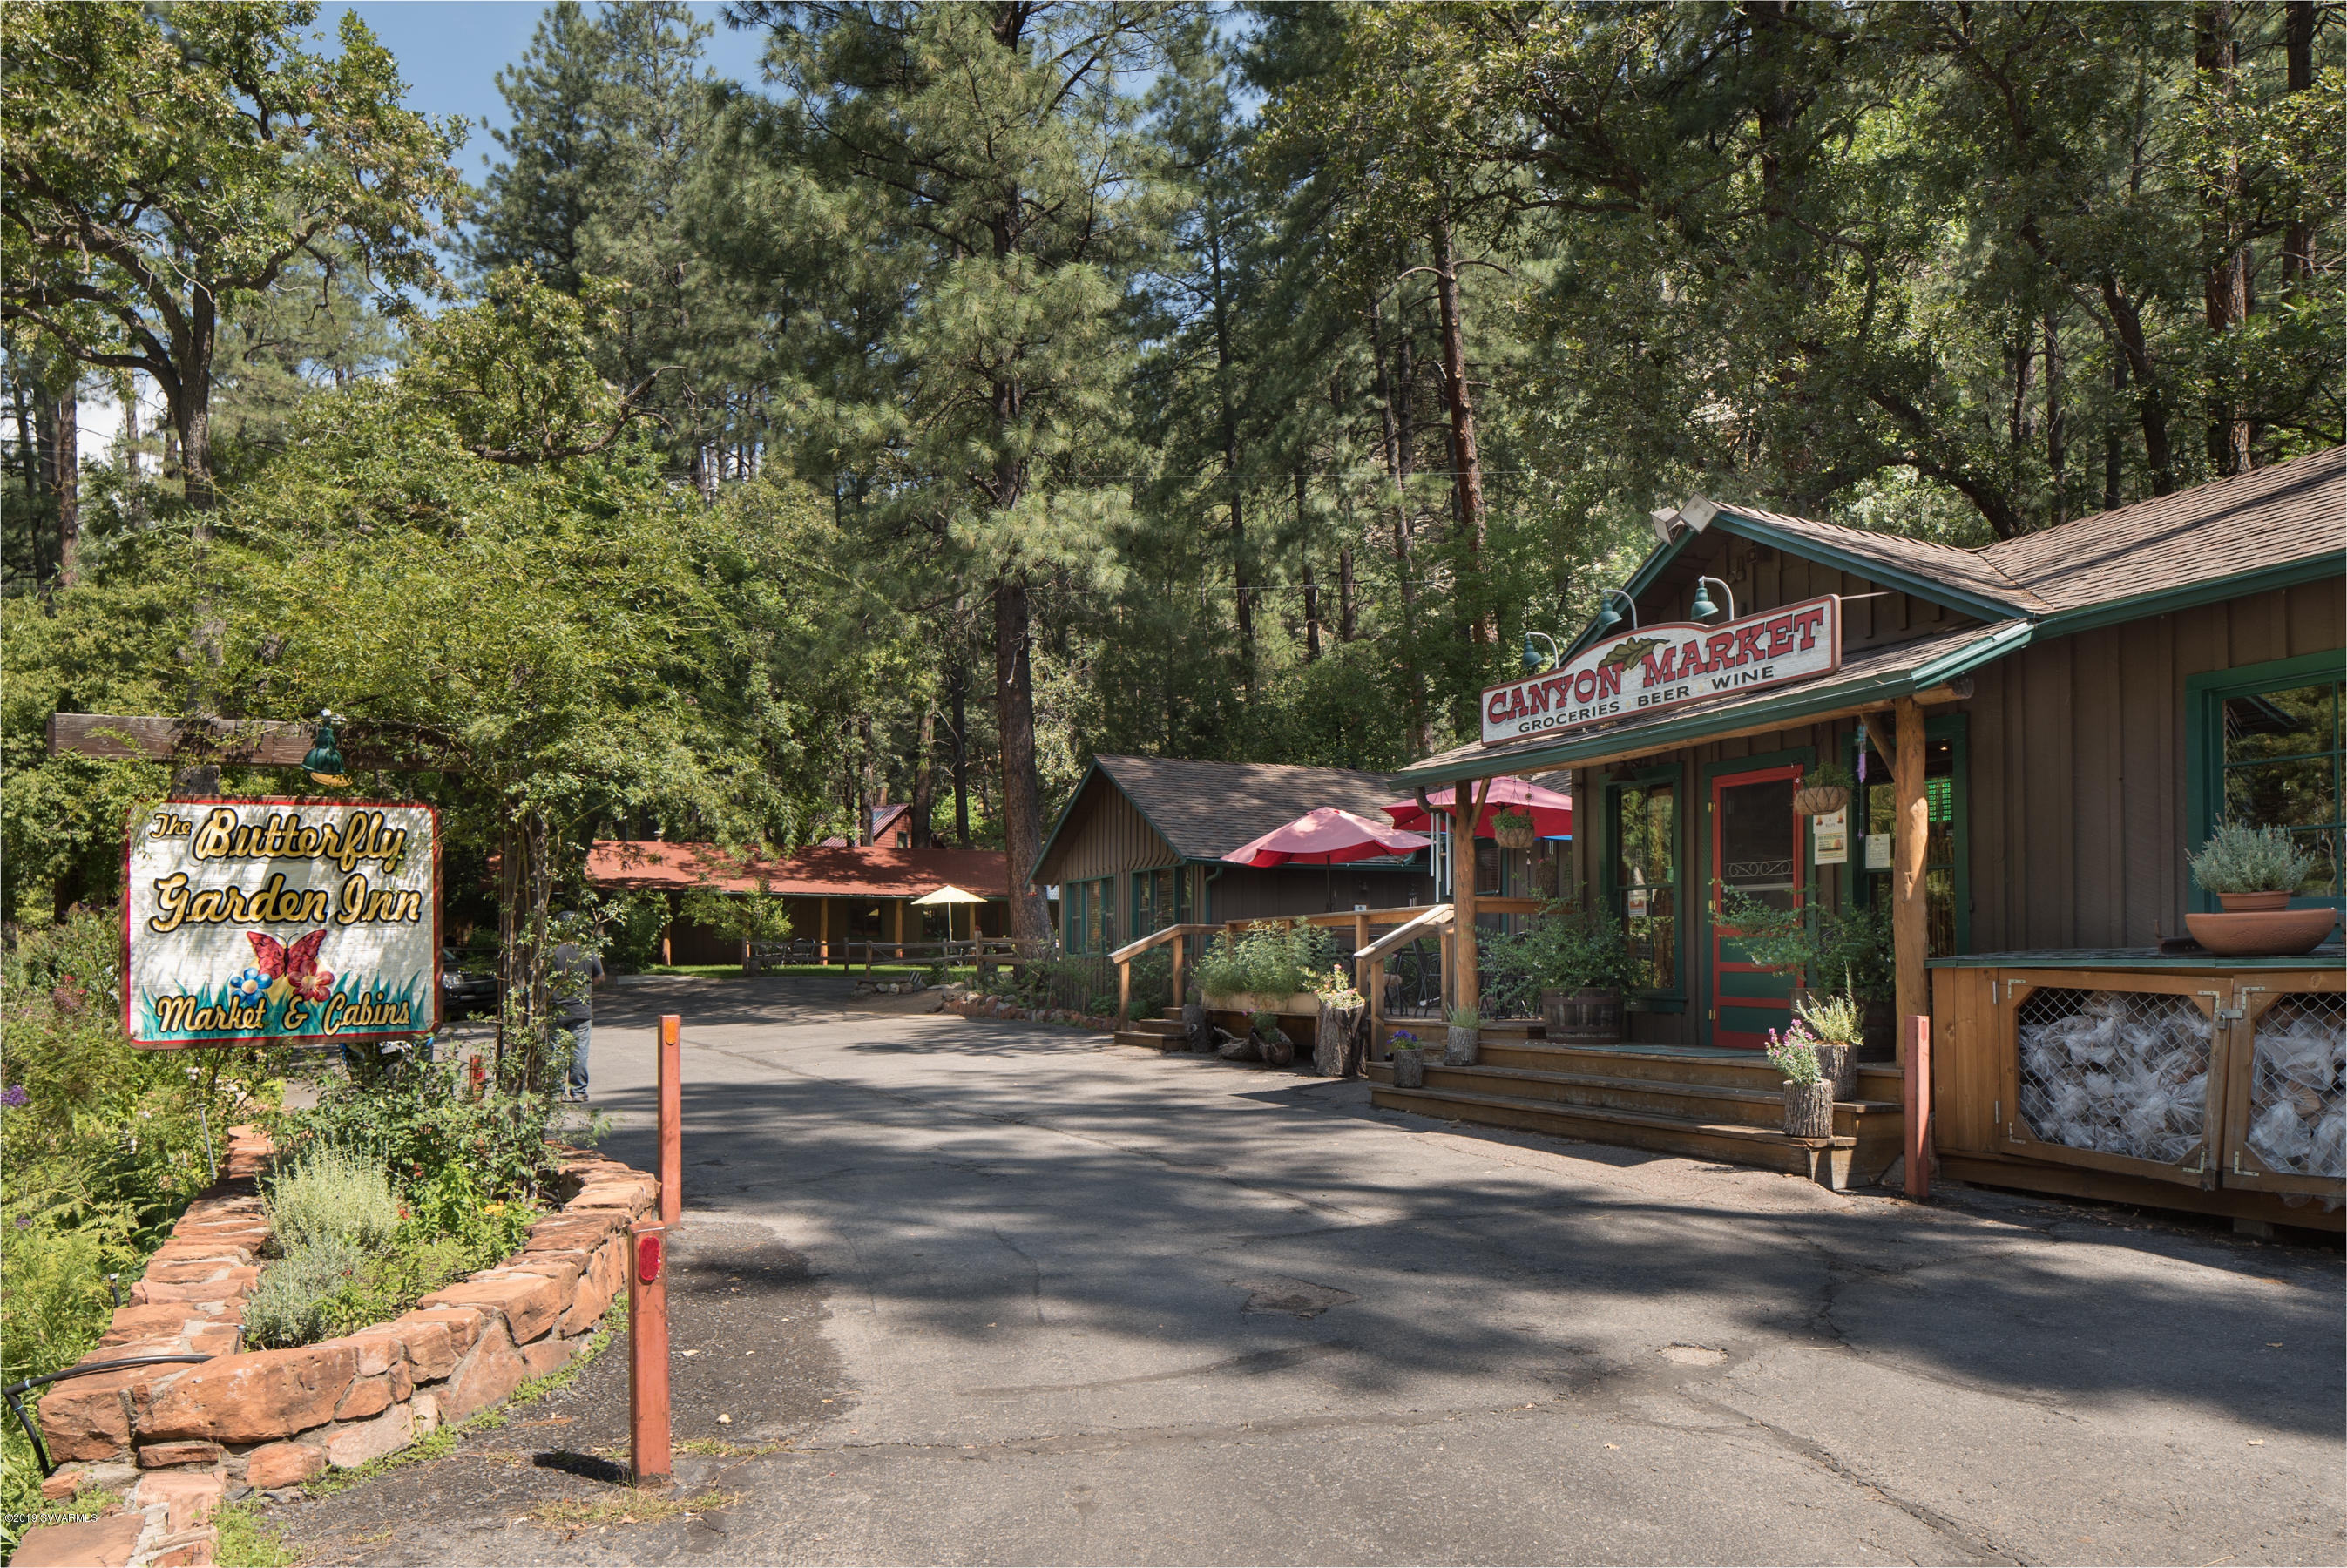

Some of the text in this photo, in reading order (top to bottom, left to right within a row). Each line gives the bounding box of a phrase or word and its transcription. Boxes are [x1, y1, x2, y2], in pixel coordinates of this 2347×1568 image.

[1487, 607, 1824, 724] CANYON MARKET
[1518, 666, 1775, 733] GROCERIES BEER WINE
[148, 808, 407, 873] The Butterfly
[149, 872, 423, 933] Garden Inn
[155, 992, 410, 1036] Market & Cabins
